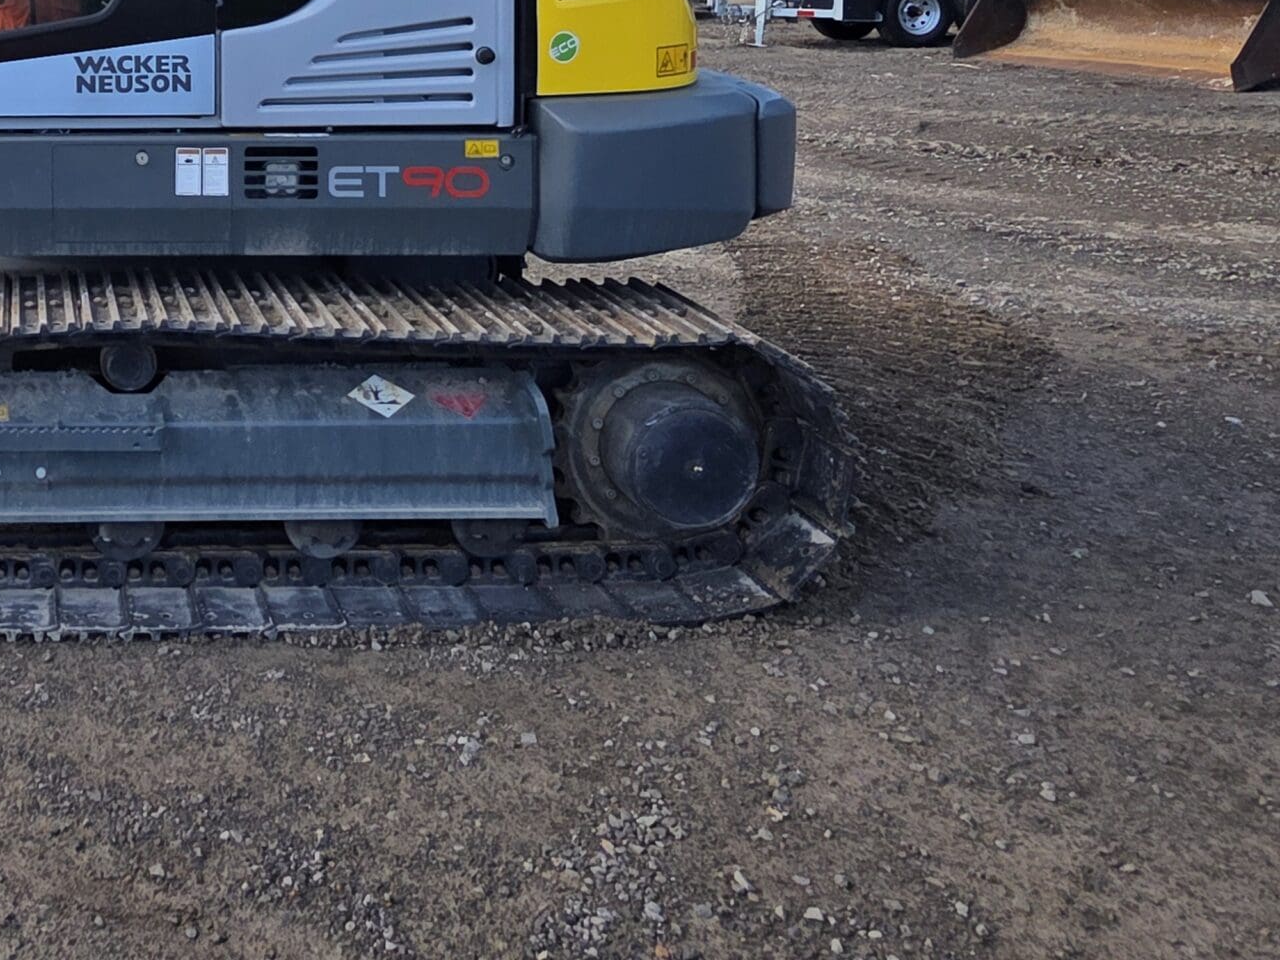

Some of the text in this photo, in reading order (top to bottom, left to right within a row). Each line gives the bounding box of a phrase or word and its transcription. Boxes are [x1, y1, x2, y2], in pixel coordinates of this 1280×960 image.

[551, 38, 578, 58] ECO
[73, 55, 191, 74] WACKER
[76, 74, 192, 93] NEUSON
[328, 165, 490, 199] ET90
